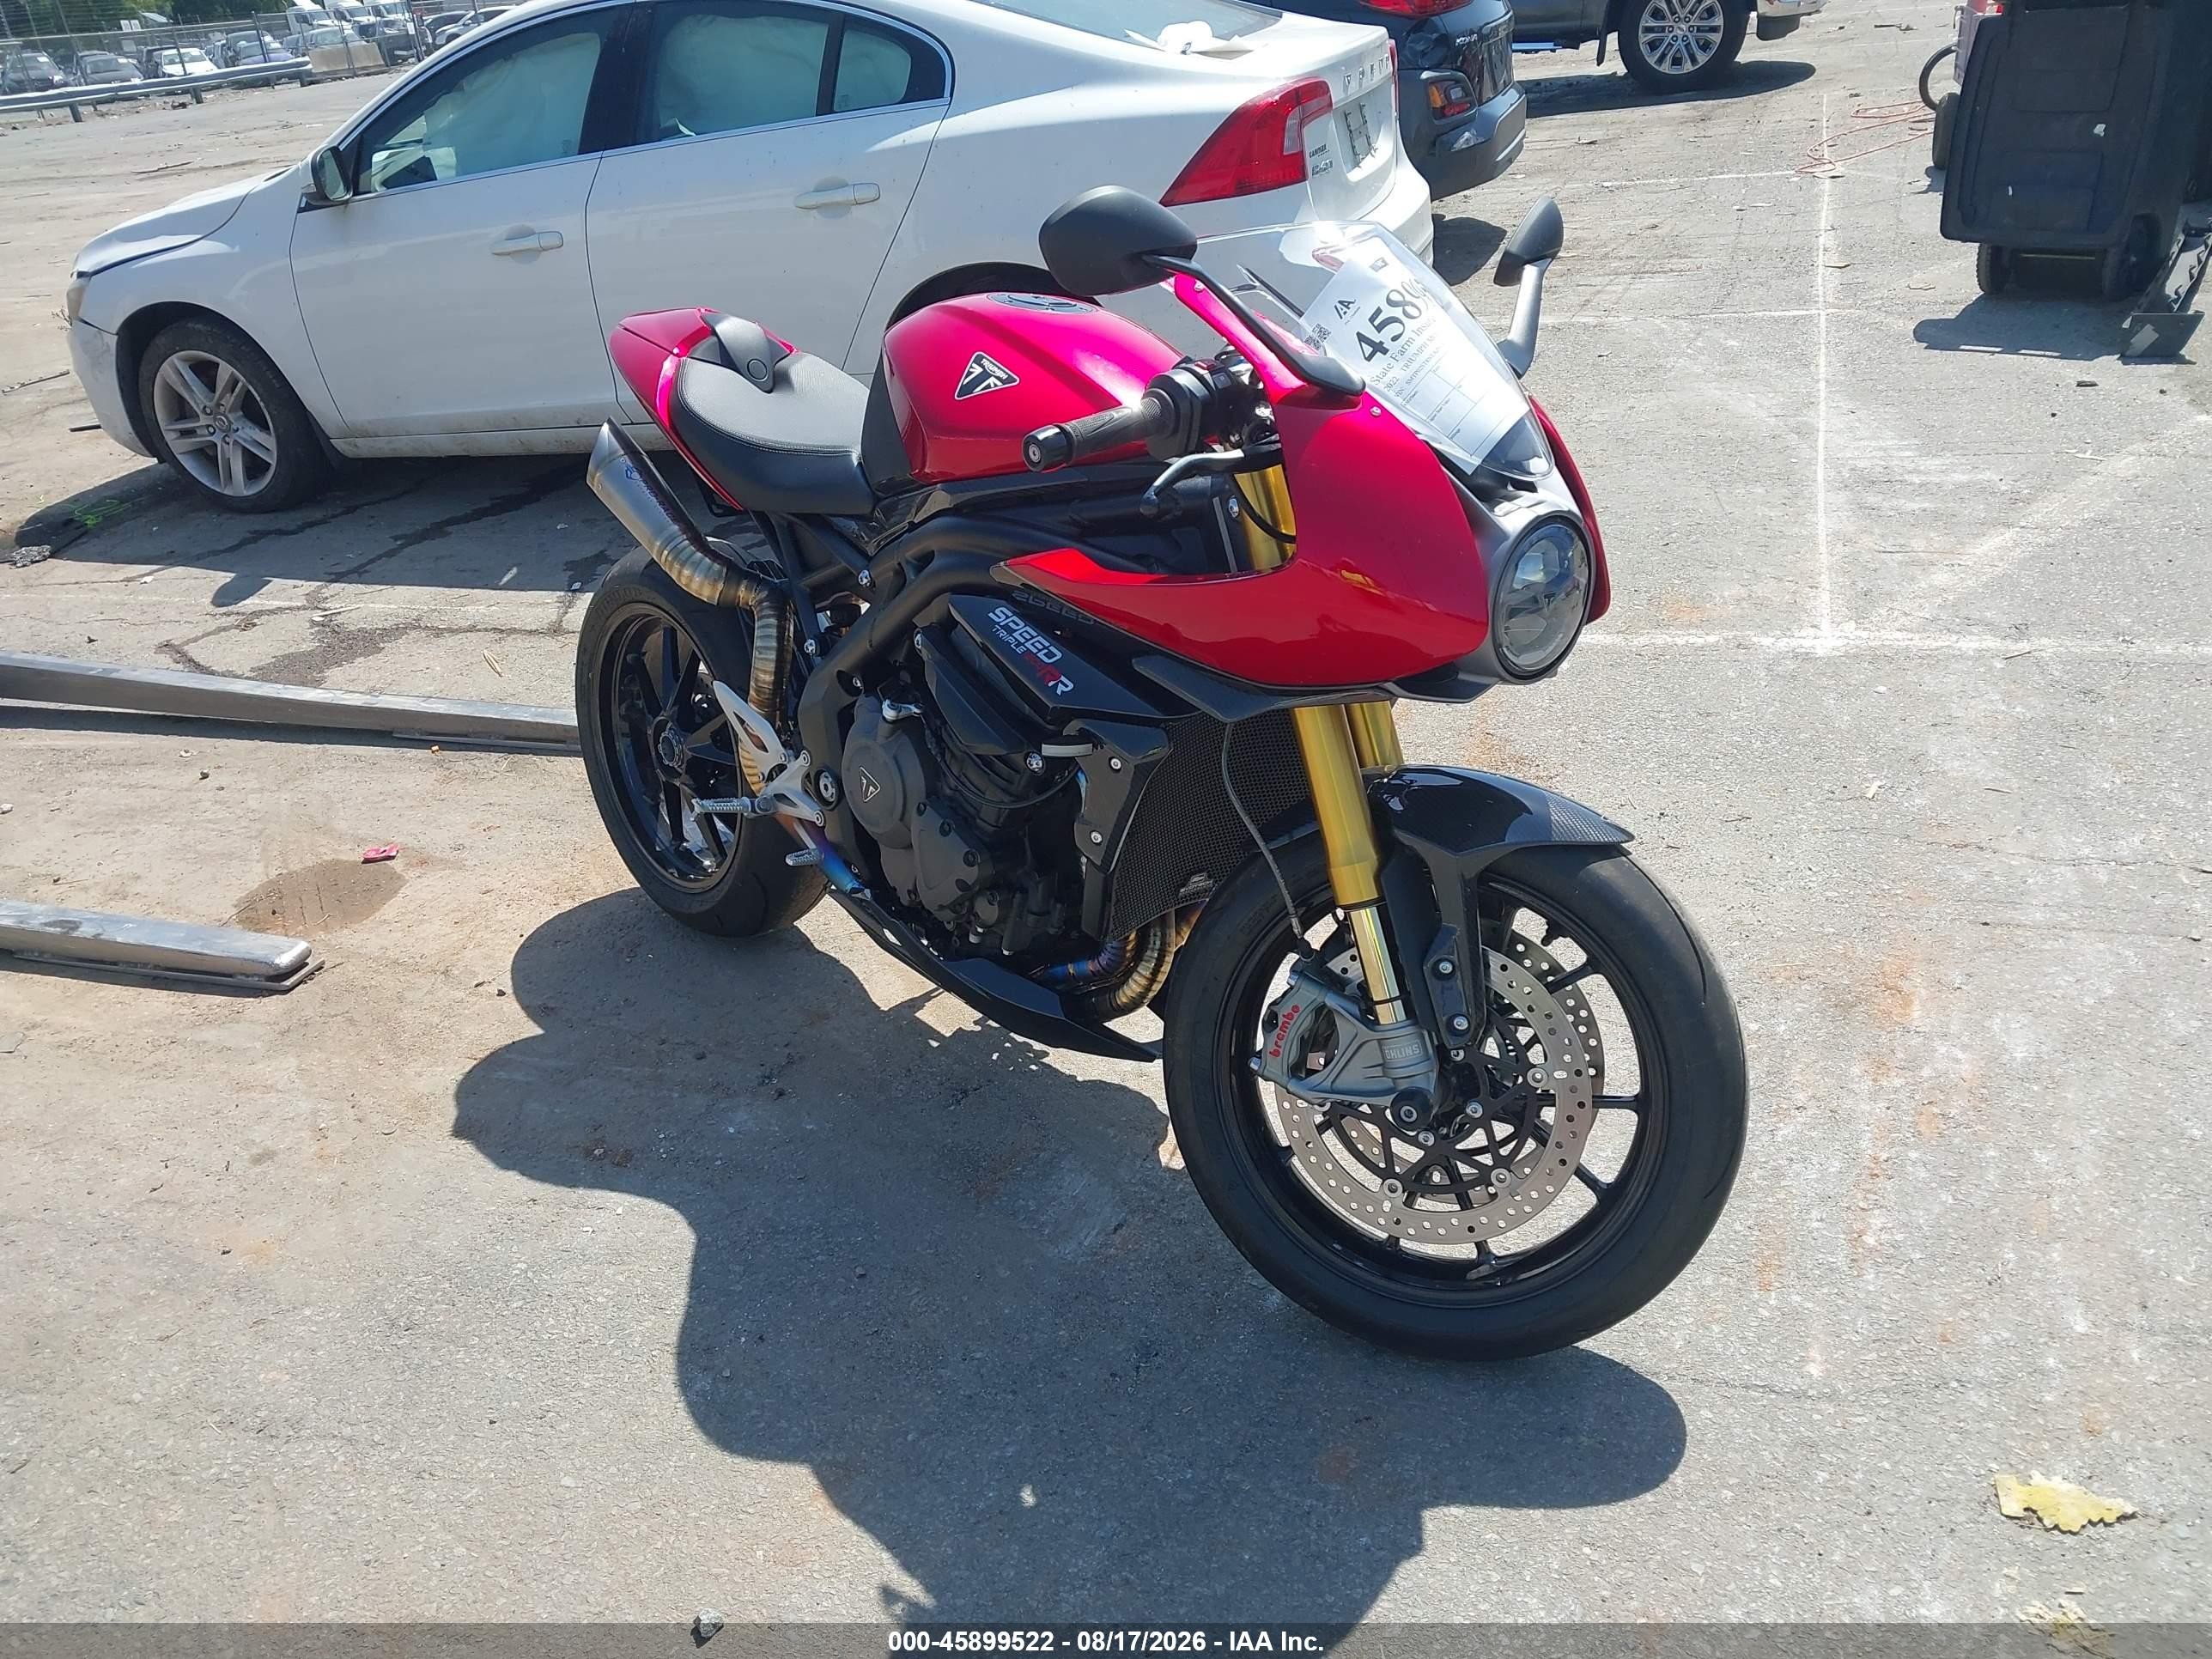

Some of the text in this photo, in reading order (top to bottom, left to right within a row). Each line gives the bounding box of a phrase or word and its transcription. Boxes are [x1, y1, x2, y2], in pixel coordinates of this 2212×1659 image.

[981, 358, 1008, 380] TRIUMPH
[1370, 362, 1395, 386] State
[1389, 337, 1416, 362] Farm
[988, 606, 1062, 664] SPEED
[991, 624, 1027, 654] TRIPLE
[1268, 1004, 1301, 1058] brembo
